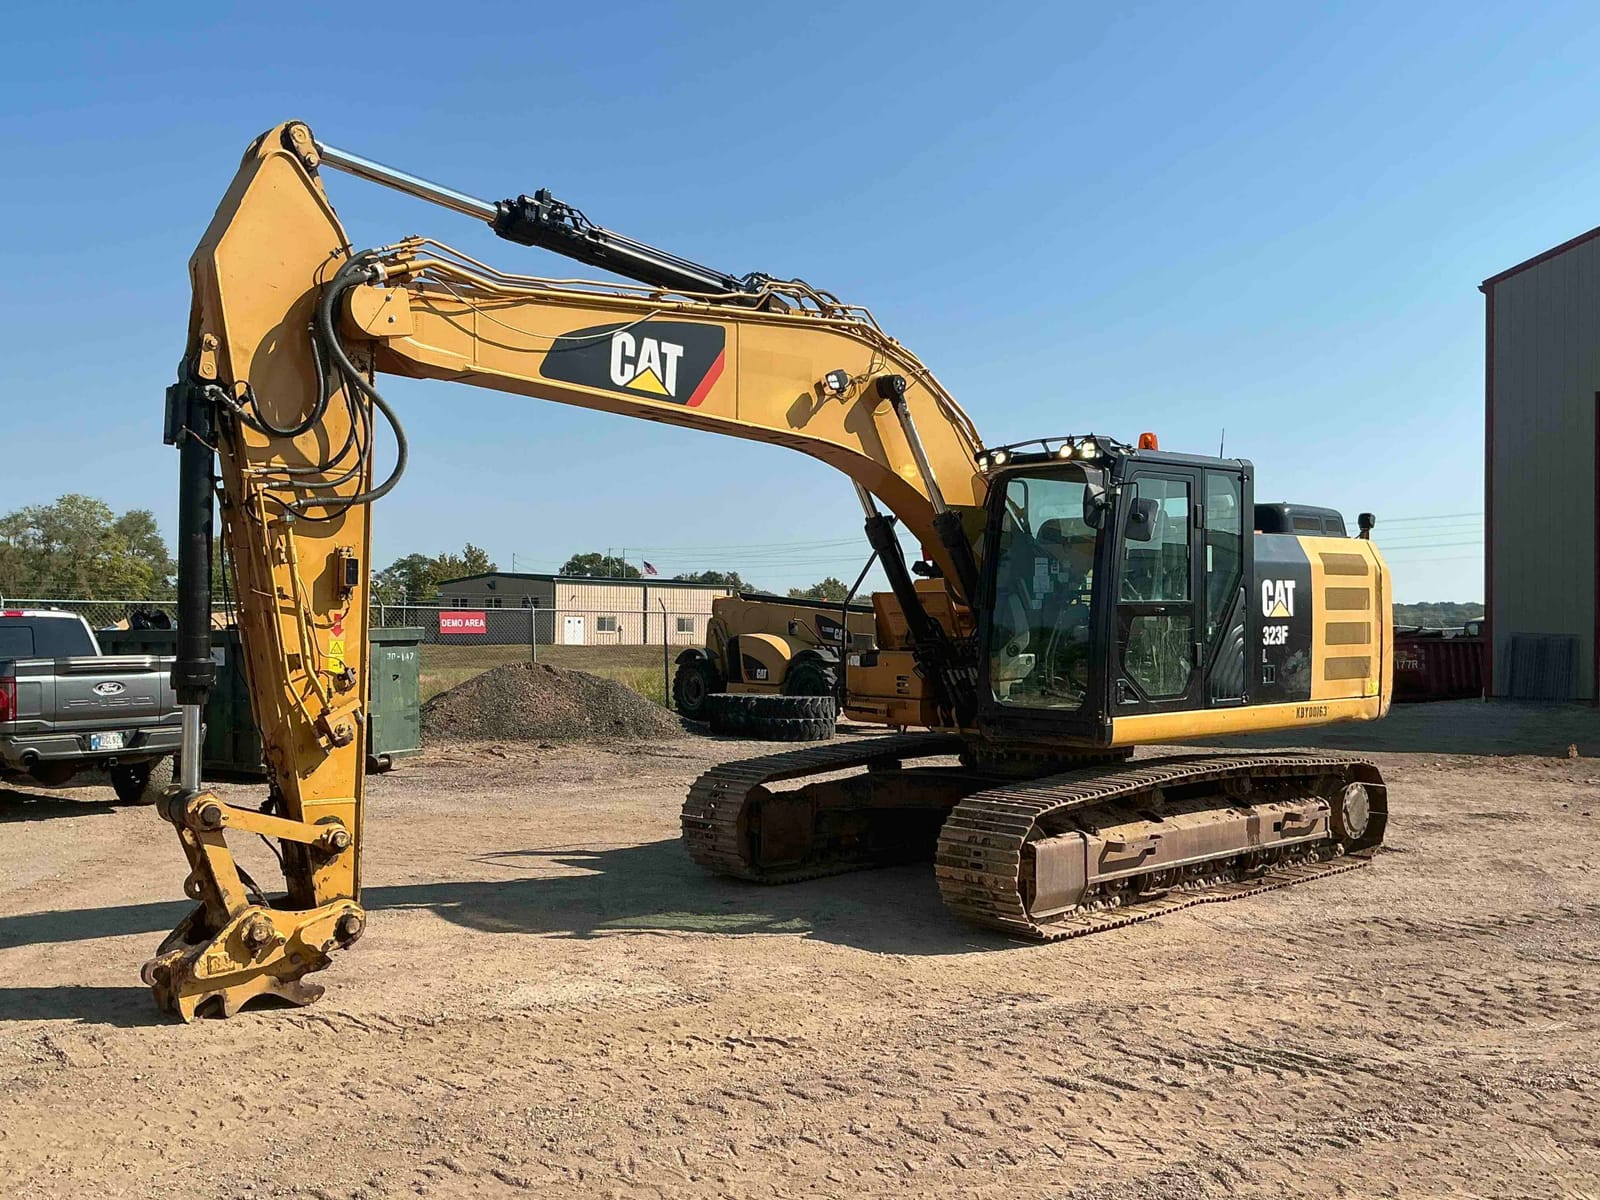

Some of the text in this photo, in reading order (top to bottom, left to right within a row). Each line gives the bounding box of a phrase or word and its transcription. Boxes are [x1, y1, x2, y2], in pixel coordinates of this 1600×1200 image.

[610, 331, 684, 397] CAT
[1262, 579, 1296, 617] CAT
[441, 618, 485, 628] DEMO AREA
[1262, 625, 1289, 646] 323F
[756, 668, 767, 679] CAT
